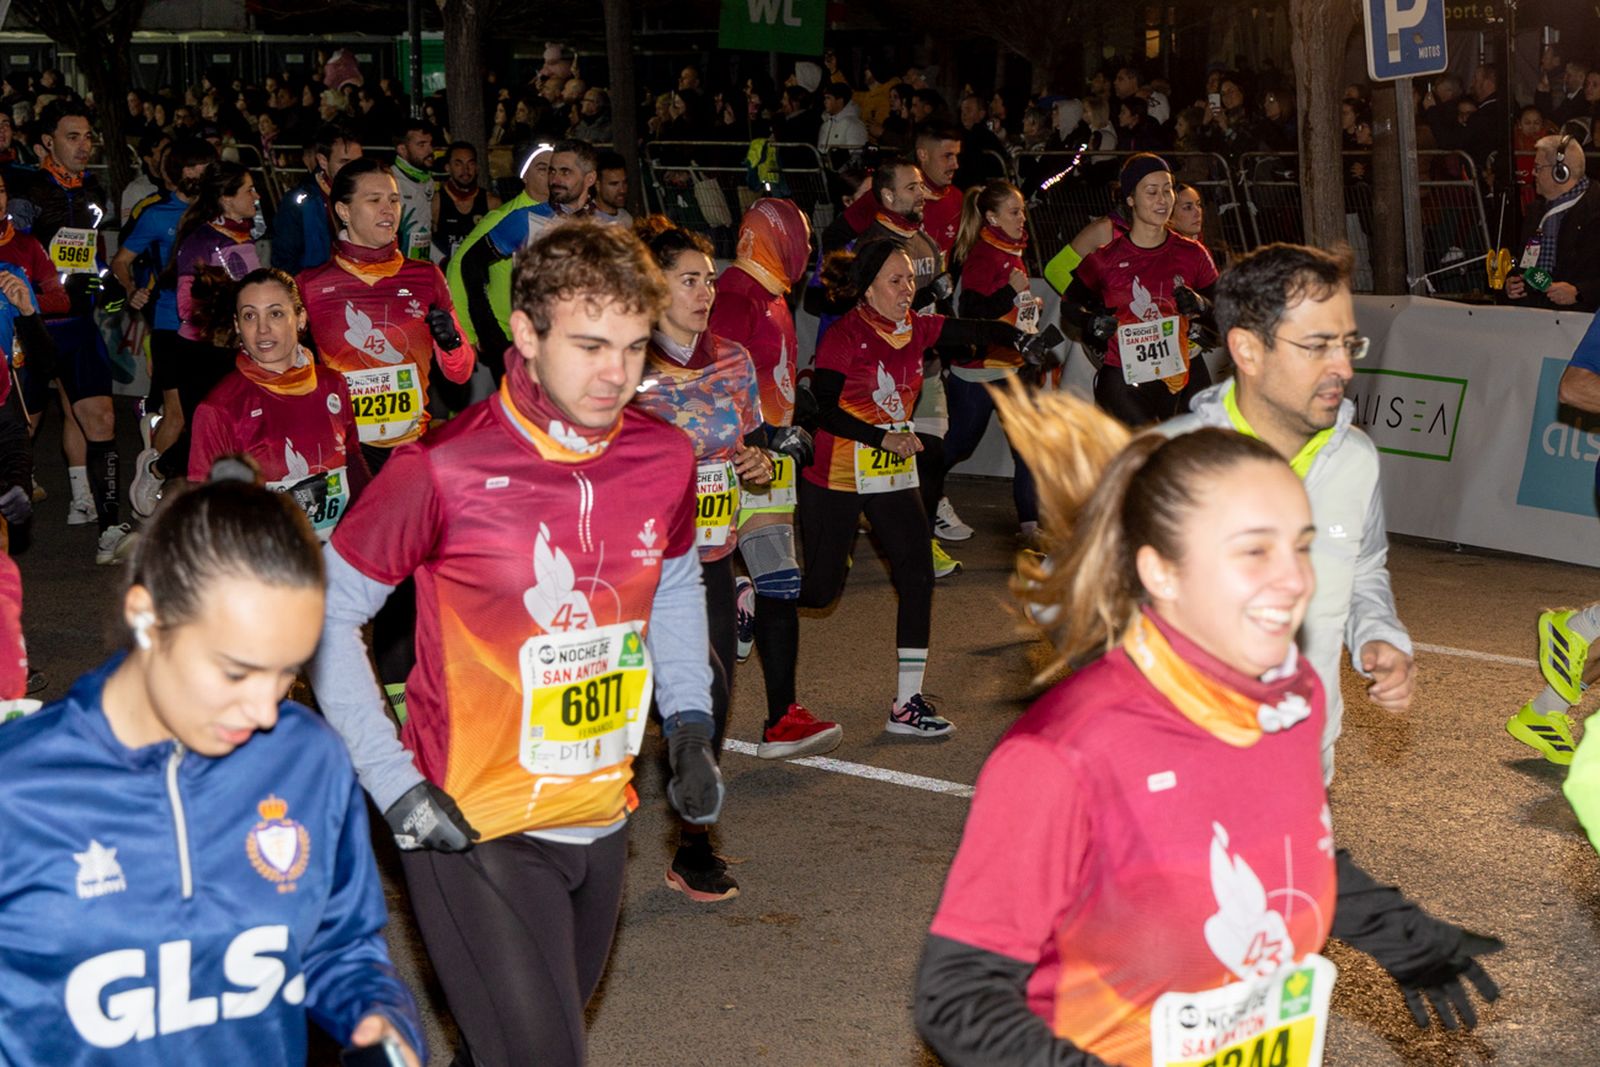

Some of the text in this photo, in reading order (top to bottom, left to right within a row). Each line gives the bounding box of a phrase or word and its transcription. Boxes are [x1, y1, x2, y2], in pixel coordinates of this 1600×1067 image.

[747, 0, 802, 27] WC
[1384, 0, 1429, 63] P
[1418, 45, 1441, 58] MOTOS
[58, 246, 90, 262] 5969
[364, 335, 386, 355] 43
[1136, 339, 1170, 362] 3411
[381, 374, 391, 384] DE
[352, 391, 411, 417] 12378
[882, 394, 899, 412] 43
[104, 451, 119, 500] Kalenji
[713, 473, 723, 481] DE
[559, 647, 597, 664] NOCHE
[598, 641, 611, 656] DE
[543, 670, 572, 685] SAN
[561, 673, 624, 727] 6877
[579, 720, 614, 739] FERNANDO
[1197, 1028, 1291, 1067] 44
